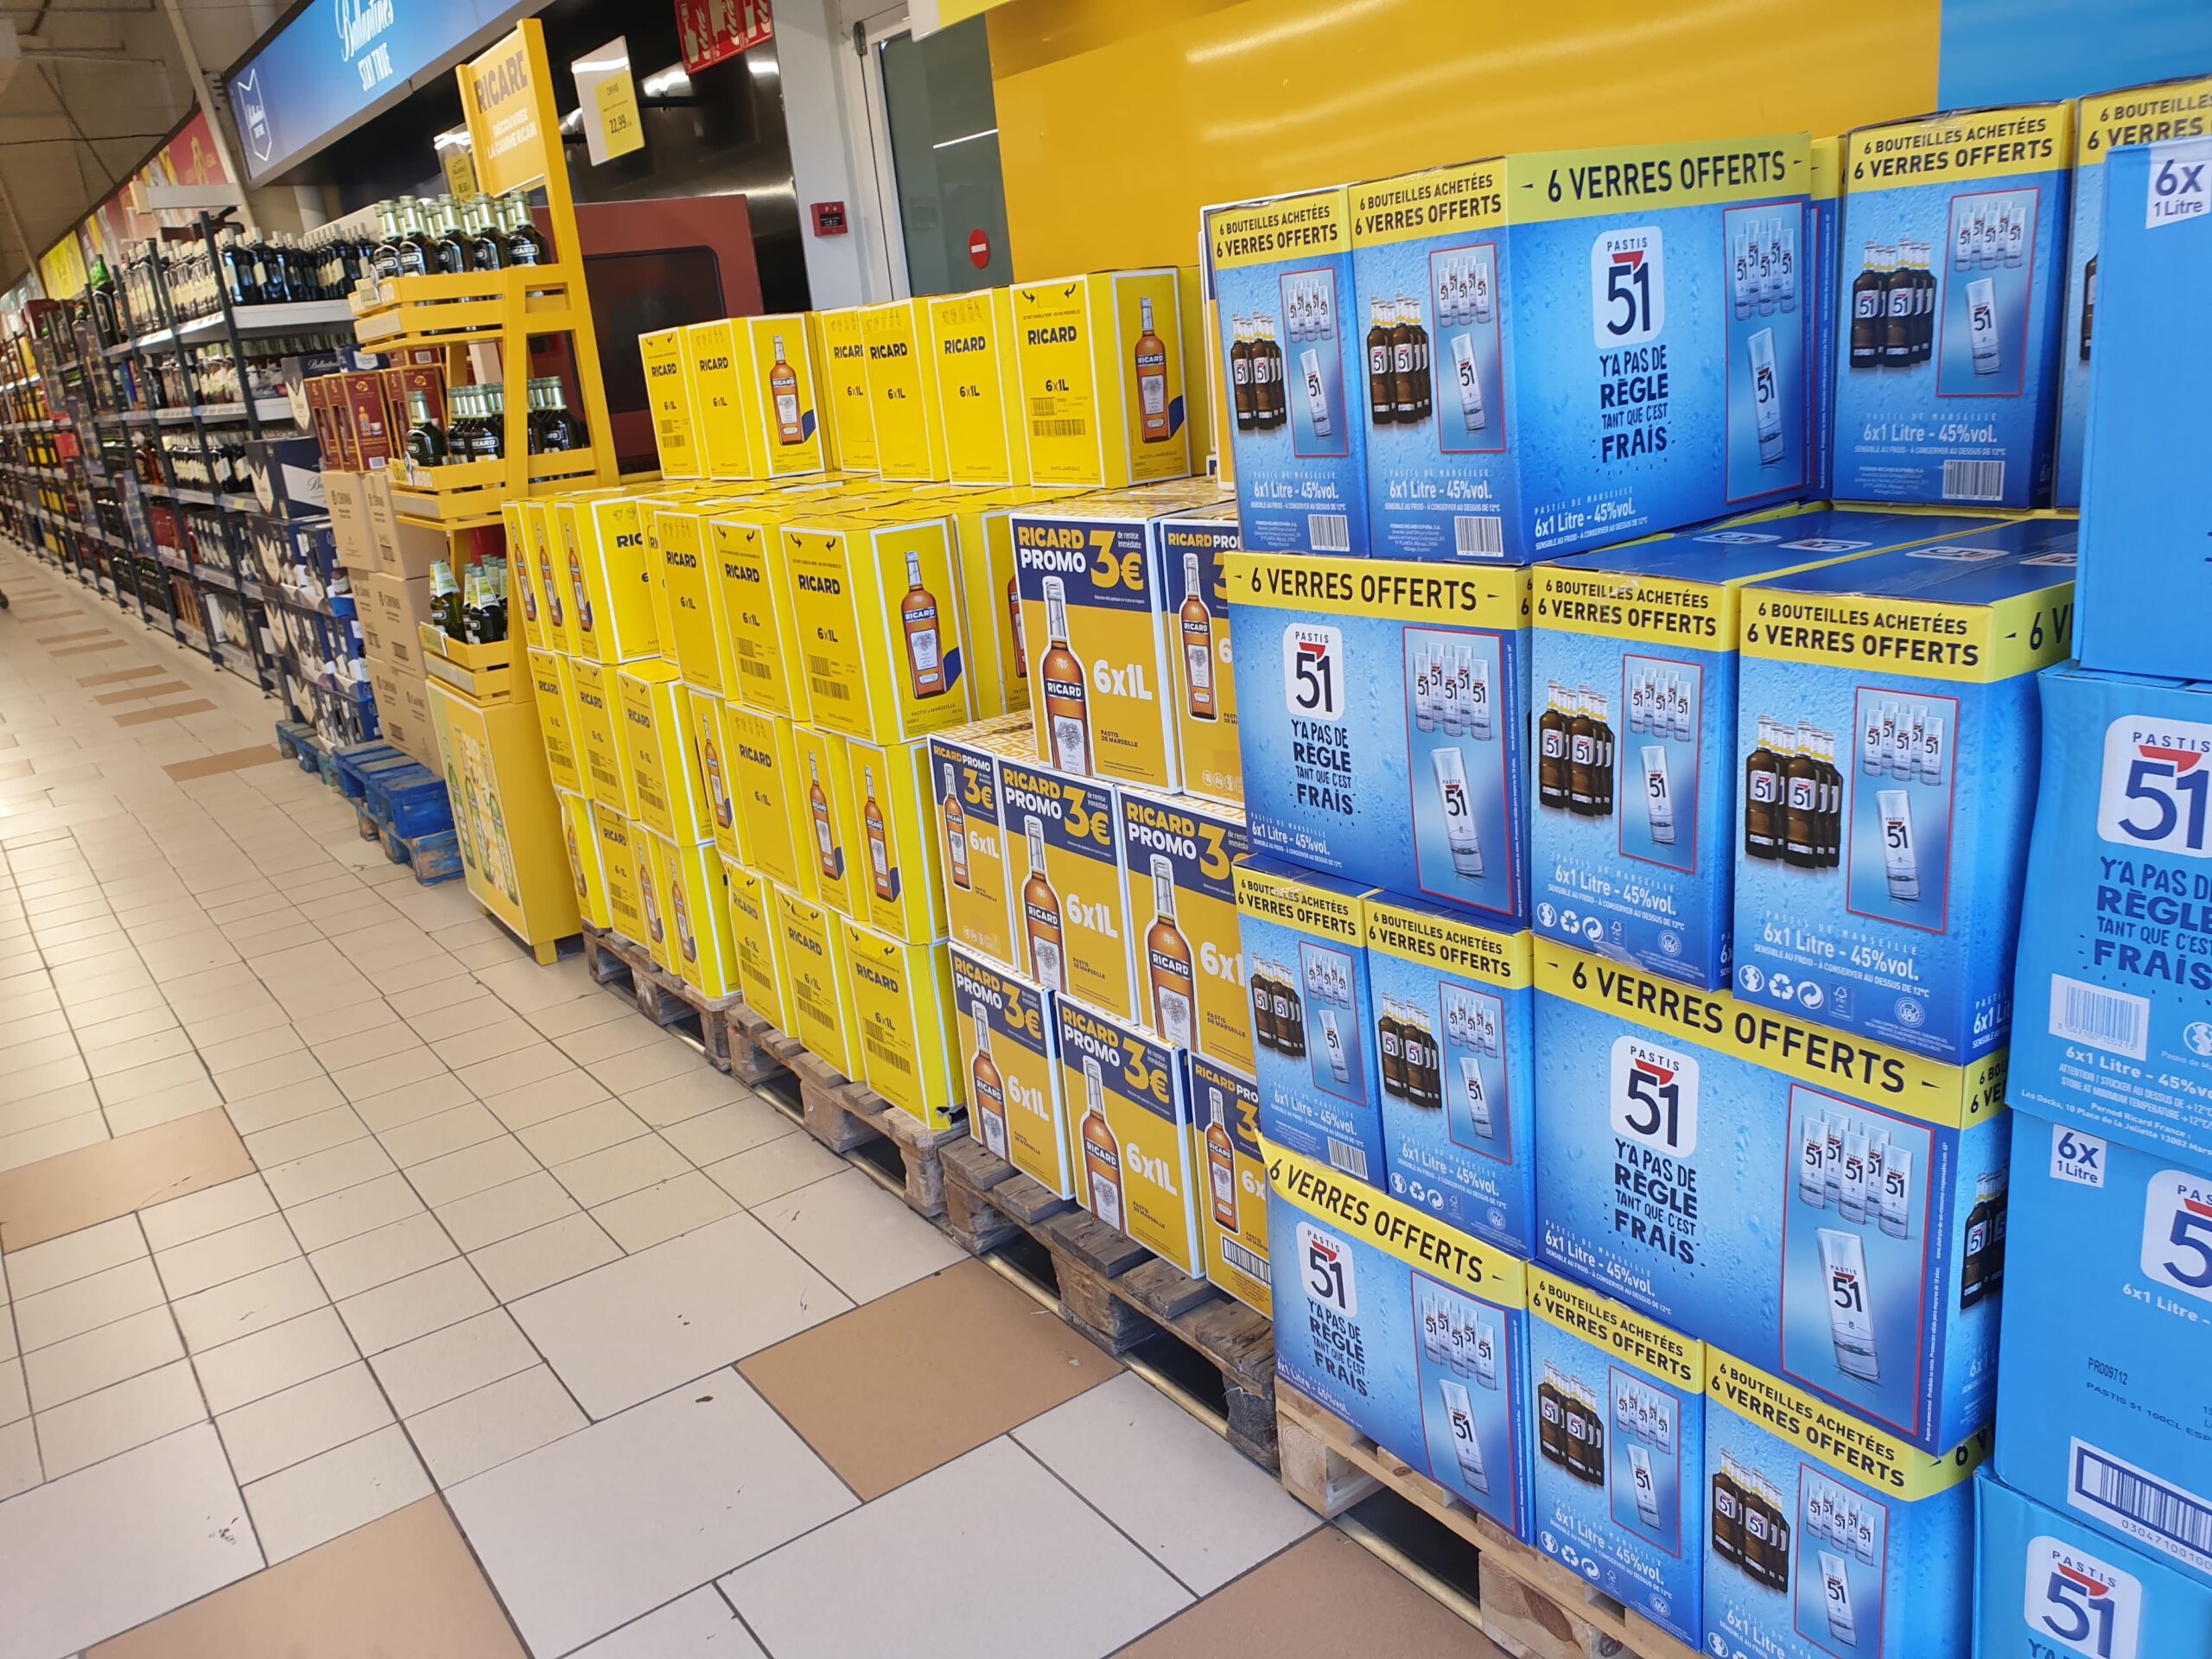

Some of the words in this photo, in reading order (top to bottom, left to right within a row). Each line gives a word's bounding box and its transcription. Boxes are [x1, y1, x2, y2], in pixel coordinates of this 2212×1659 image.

[1875, 130, 1962, 153] BOUTEILLES
[1967, 116, 2046, 142] ACHETÉES
[2107, 117, 2203, 147] VERRES
[1548, 169, 1562, 202] 6
[1569, 160, 1672, 200] VERRES
[1680, 150, 1785, 189] OFFERTS
[1870, 152, 1948, 178] VERRES
[1955, 138, 2053, 167] OFFERTS
[1368, 185, 1431, 209] BOUTEILLES
[1434, 172, 1493, 197] ACHETÉES
[2155, 159, 2206, 196] 6x
[1366, 207, 1424, 233] VERRES
[1428, 194, 1502, 223] OFFERTS
[2164, 198, 2203, 216] Litre
[1224, 233, 1274, 256] VERRES
[1277, 223, 1338, 249] OFFERTS
[1226, 218, 1279, 234] BOUTEILLES
[1607, 237, 1648, 252] PASTIS
[1606, 261, 1650, 335] 51
[869, 342, 908, 360] RICARD
[944, 335, 986, 354] RICARD
[1027, 326, 1077, 346] RICARD
[652, 363, 677, 377] RICARD
[700, 356, 728, 372] RICARD
[1046, 378, 1070, 392] 6x1L
[1018, 527, 1085, 550] RICARD
[1168, 532, 1212, 548] RICARD
[666, 551, 696, 569] RICARD
[725, 563, 760, 582] RICARD
[1020, 548, 1087, 573] PROMO
[798, 574, 841, 595] RICARD
[1267, 568, 1353, 601] VERRES
[1361, 575, 1478, 612] OFFERTS
[1555, 581, 1633, 601] BOUTEILLES
[1637, 588, 1708, 609] ACHETÉES
[1551, 598, 1623, 625] VERRES
[1628, 608, 1716, 637] OFFERTS
[1771, 603, 1870, 626] BOUTEILLES
[1873, 612, 1967, 636] ACHETÉES
[1294, 631, 1329, 643] PASTIS
[1765, 624, 1854, 653] VERRES
[1862, 634, 1979, 667] OFFERTS
[1047, 681, 1082, 697] RICARD
[1093, 659, 1153, 702] 6x1L
[1295, 651, 1333, 713] 51
[740, 744, 772, 767] RICARD
[2133, 731, 2211, 753] PASTIS
[1002, 769, 1061, 798] RICARD
[1006, 786, 1063, 820] PROMO
[1126, 801, 1196, 838] RICARD
[2117, 760, 2209, 850] 51
[969, 830, 1001, 859] 6x1L
[1128, 822, 1197, 861] PROMO
[1580, 869, 1611, 897] Litre
[1066, 893, 1118, 938] 6x1L
[1246, 893, 1294, 919] VERRES
[1297, 907, 1356, 937] OFFERTS
[788, 926, 823, 956] RICARD
[1381, 914, 1443, 939] BOUTEILLES
[1446, 931, 1503, 956] ACHETÉES
[1764, 921, 1790, 945] 6x1
[1796, 933, 1834, 959] Litre
[1153, 956, 1189, 976] RICARD
[1379, 930, 1436, 957] VERRES
[1440, 945, 1511, 978] OFFERTS
[855, 963, 899, 994] RICARD
[954, 956, 1001, 992] RICARD
[956, 972, 1002, 1010] PROMO
[1062, 1006, 1119, 1047] RICARD
[1572, 961, 1588, 989] 6
[1596, 968, 1723, 1034] VERRES
[1735, 1013, 1905, 1094] OFFERTS
[1065, 1025, 1120, 1067] PROMO
[1630, 1045, 1680, 1071] PASTIS
[2065, 1046, 2094, 1065] 6x1
[2099, 1056, 2141, 1078] Litre
[1195, 1063, 1236, 1092] RICARD
[1007, 1075, 1049, 1122] 6x1L
[1624, 1068, 1679, 1149] 51
[2077, 1107, 2100, 1122] Place
[2101, 1115, 2113, 1125] de
[2124, 1122, 2158, 1139] Joliette
[2160, 1134, 2188, 1147] 13002
[2091, 1103, 2122, 1119] Pernod
[2124, 1111, 2153, 1127] Ricard
[2155, 1122, 2186, 1137] France
[2057, 1132, 2100, 1169] 6x
[1126, 1142, 1178, 1197] 6x1L
[1643, 1149, 1673, 1182] PAS
[1678, 1164, 1697, 1193] DE
[2066, 1162, 2098, 1184] Litre
[1287, 1164, 1370, 1227] VERRES
[1374, 1210, 1483, 1283] OFFERTS
[1616, 1189, 1642, 1212] TANT
[1645, 1204, 1663, 1224] QUE
[1567, 1239, 1596, 1268] Litre
[1310, 1247, 1346, 1310] 51
[1832, 1275, 1863, 1313] 51
[1548, 1282, 1618, 1326] BOUTEILLES
[1620, 1319, 1683, 1357] ACHETÉES
[2122, 1282, 2152, 1303] 6x1
[2157, 1296, 2198, 1322] Litre
[1545, 1296, 1608, 1341] VERRES
[1612, 1331, 1692, 1381] OFFERTS
[2088, 1357, 2128, 1385] PR009712
[1730, 1363, 1814, 1419] BOUTEILLES
[1816, 1414, 1895, 1462] ACHETÉES
[2087, 1382, 2127, 1406] PASTIS
[2129, 1402, 2142, 1413] 51
[2146, 1409, 2183, 1432] 100CL
[1726, 1382, 1800, 1434] VERRES
[1806, 1429, 1905, 1488] OFFERTS
[2052, 1550, 2116, 1588] PASTIS
[2042, 1571, 2115, 1659] 51
